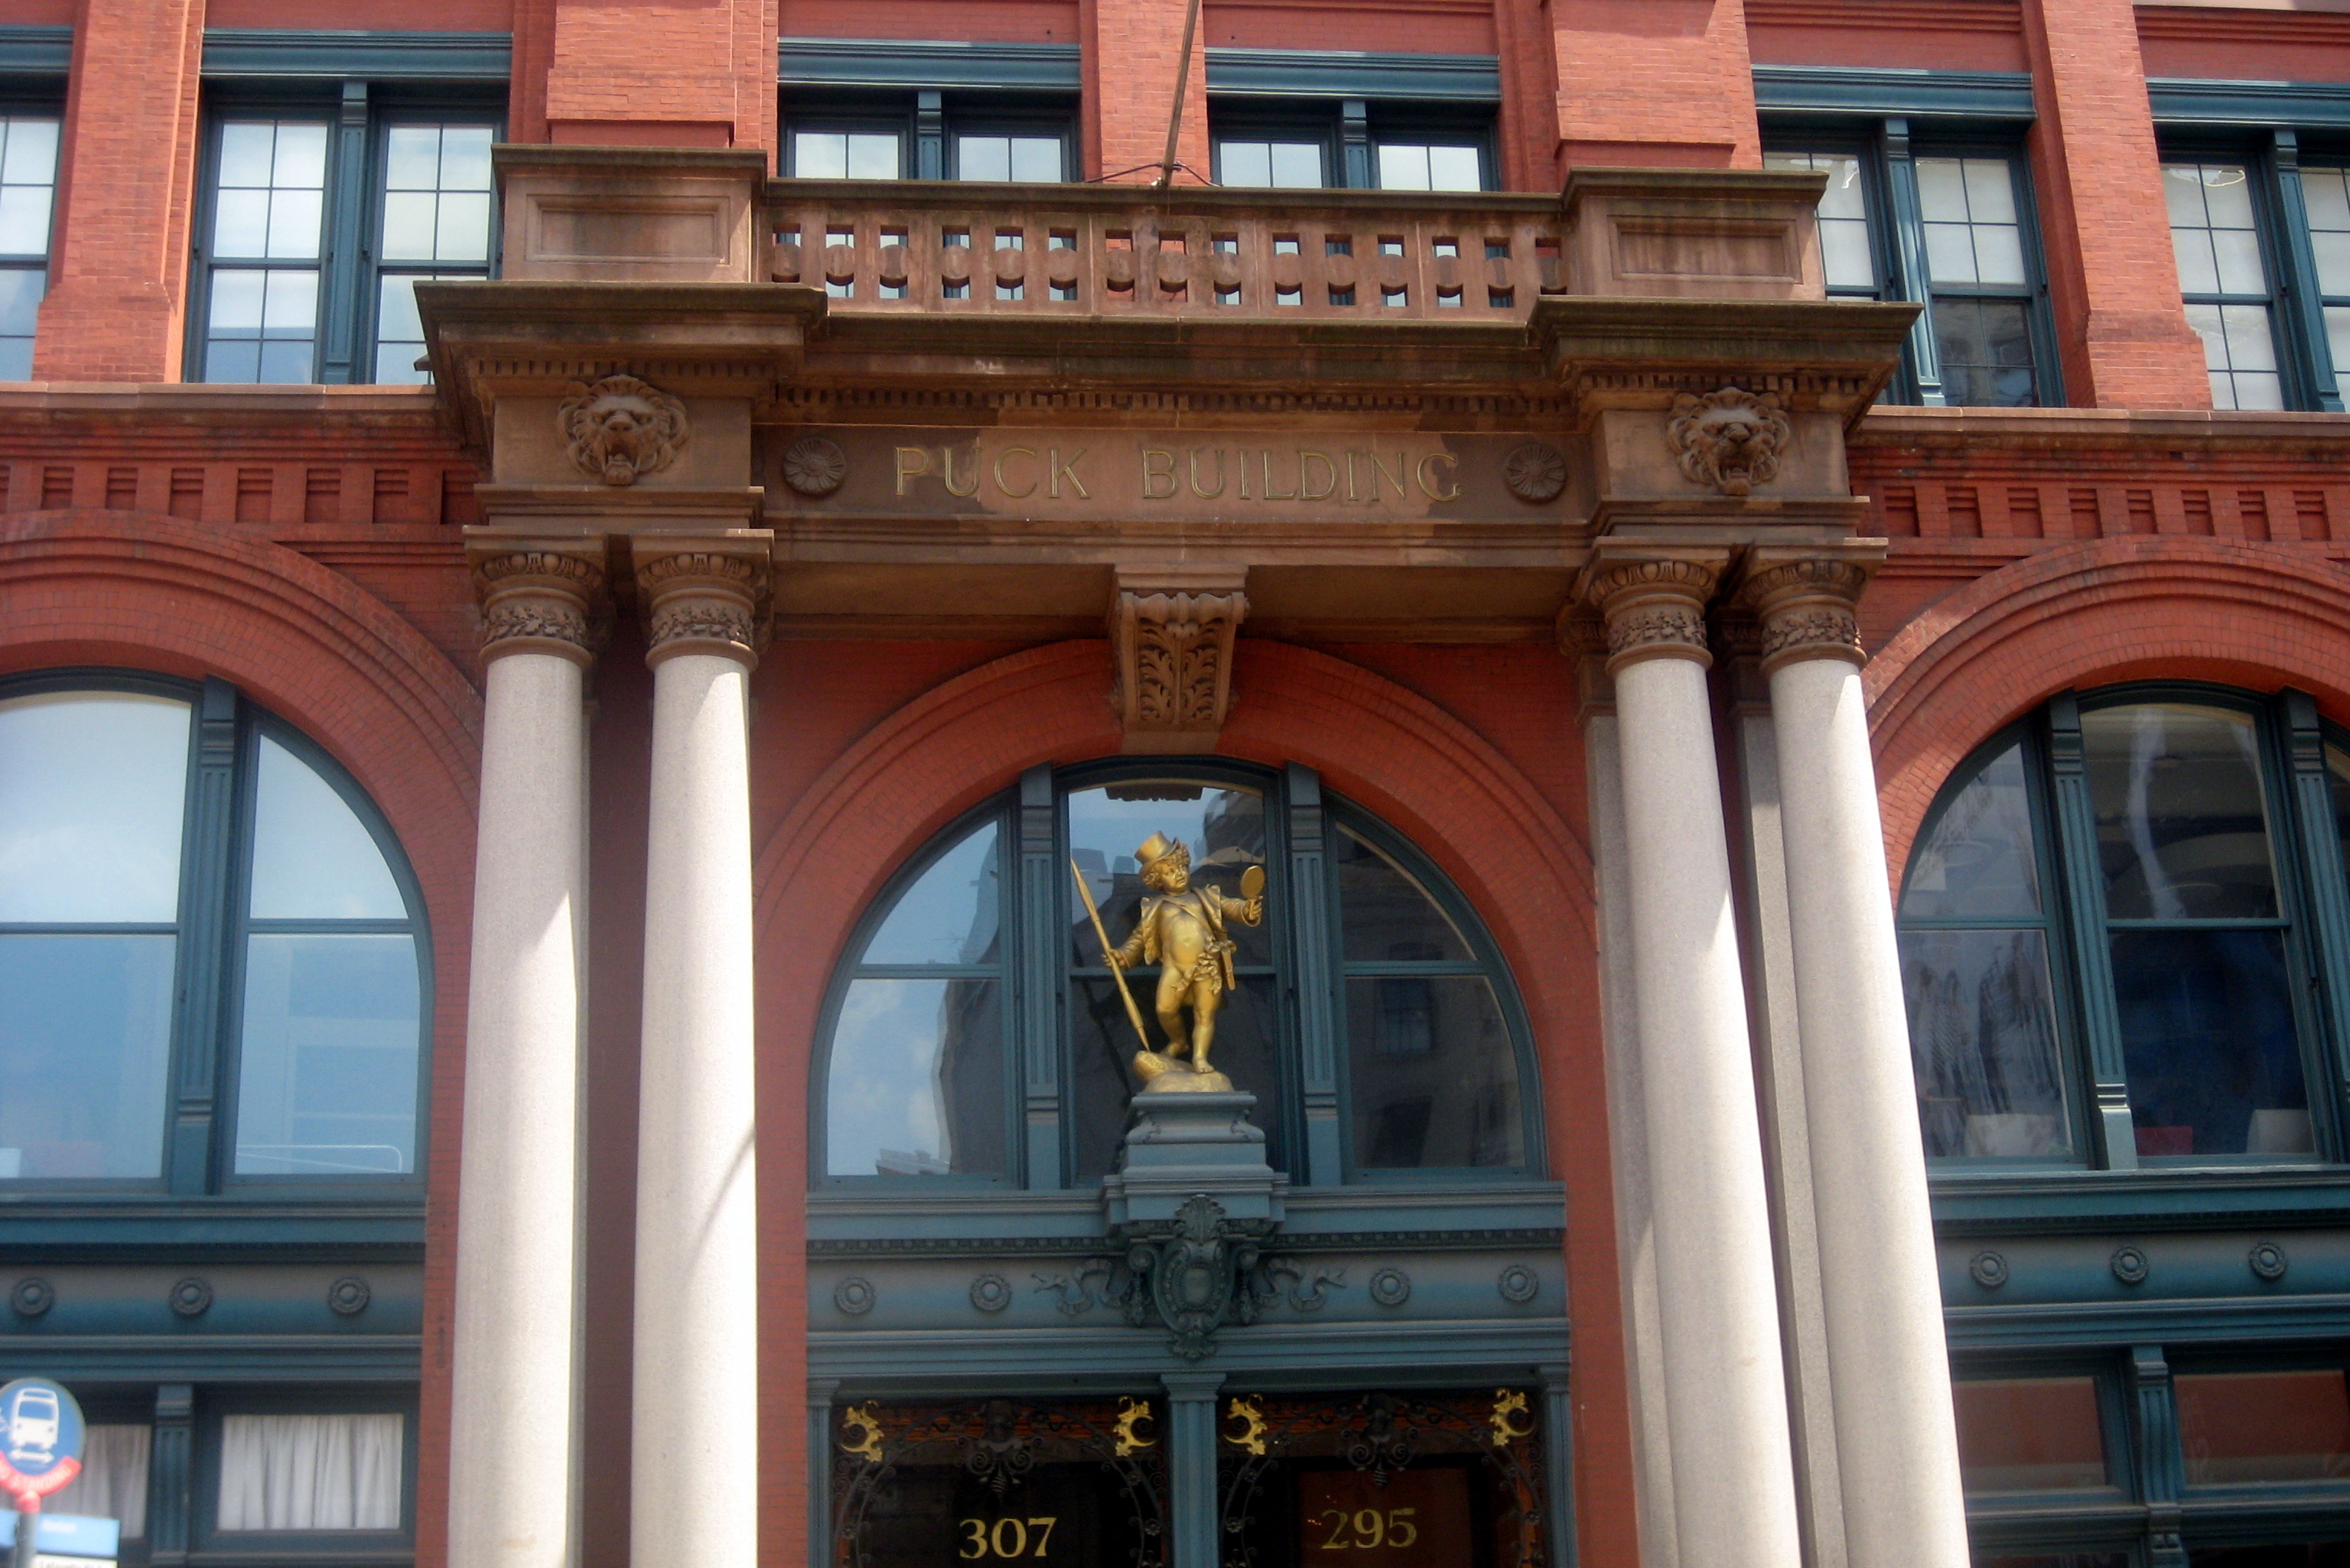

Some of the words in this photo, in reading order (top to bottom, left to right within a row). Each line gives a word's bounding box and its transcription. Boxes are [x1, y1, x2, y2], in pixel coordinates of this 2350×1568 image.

[894, 447, 1091, 499] PUCK
[1141, 448, 1462, 502] BUILDING
[959, 1516, 1057, 1559] 307
[1320, 1507, 1417, 1550] 295
